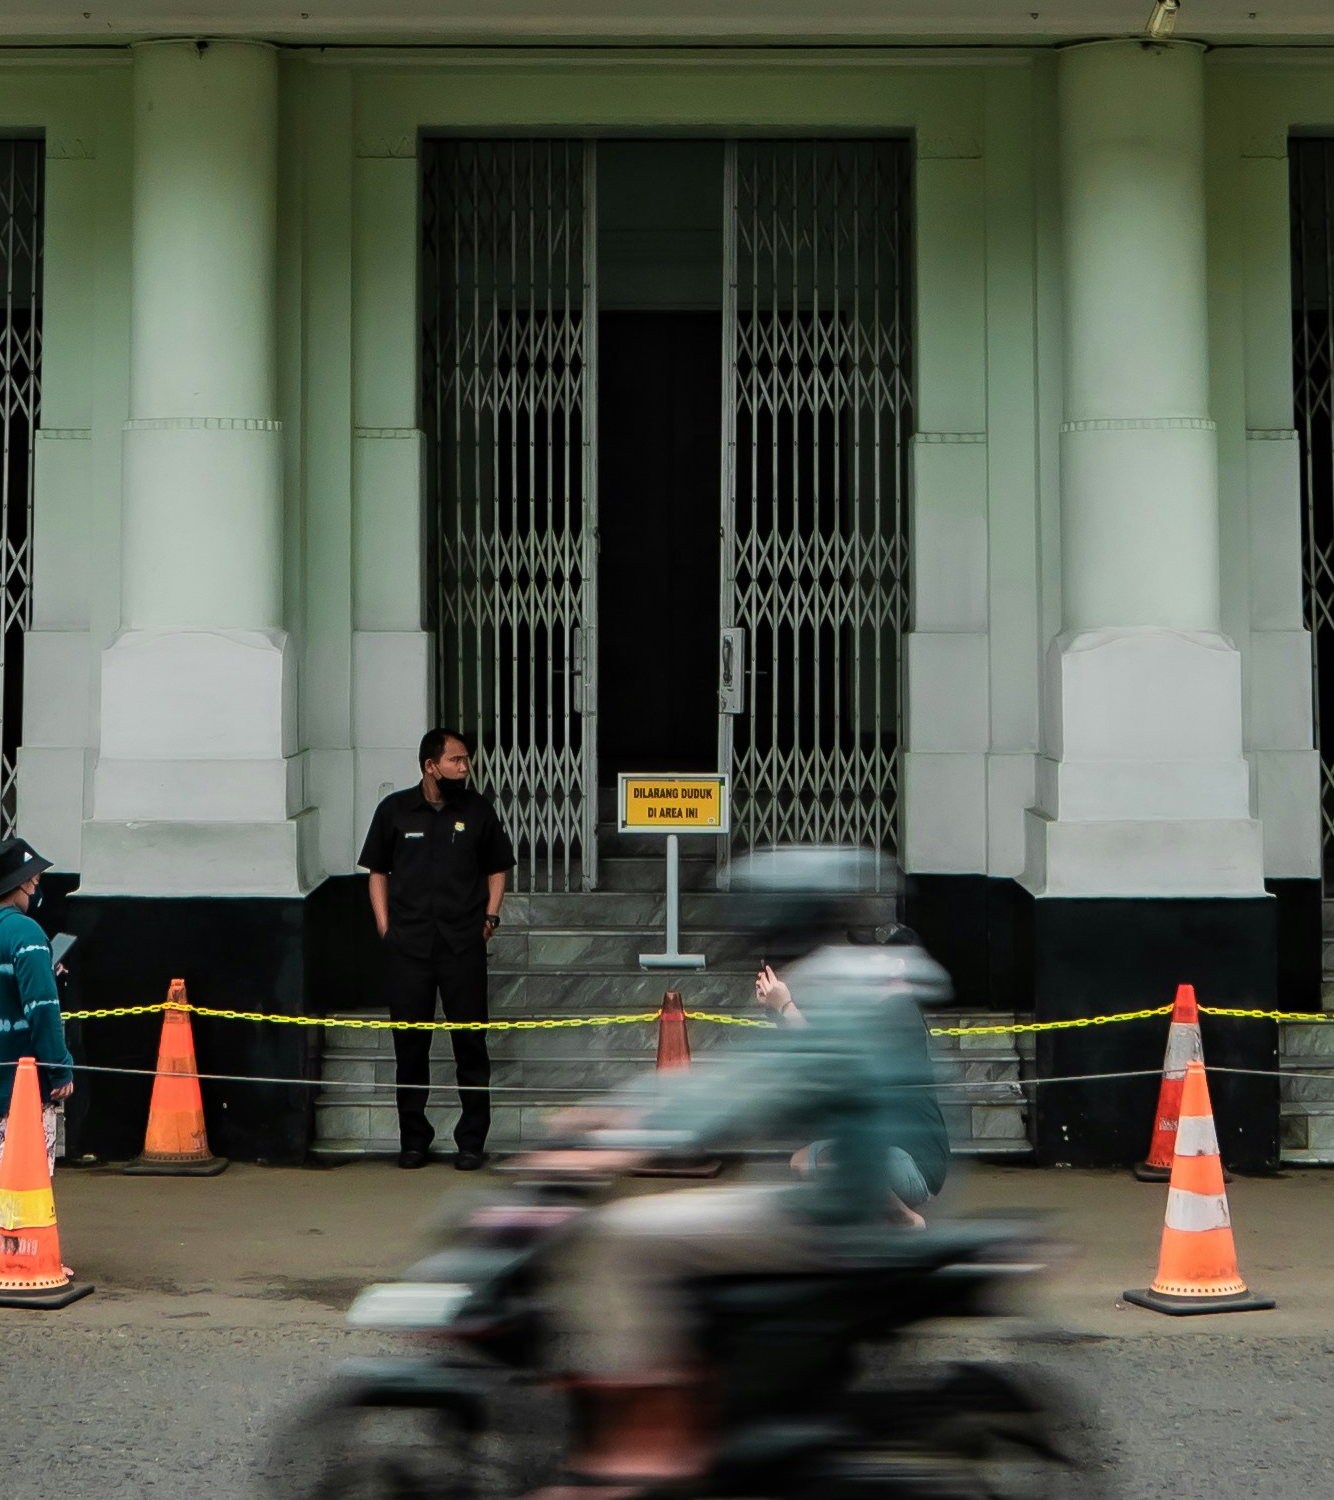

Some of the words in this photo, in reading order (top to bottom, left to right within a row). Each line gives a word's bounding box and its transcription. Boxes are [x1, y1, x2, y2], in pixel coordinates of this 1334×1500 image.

[633, 787, 678, 799] DILARANG
[681, 788, 713, 799] DUDUK
[647, 807, 657, 818] DI
[659, 807, 683, 818] AREA
[685, 807, 699, 818] INI
